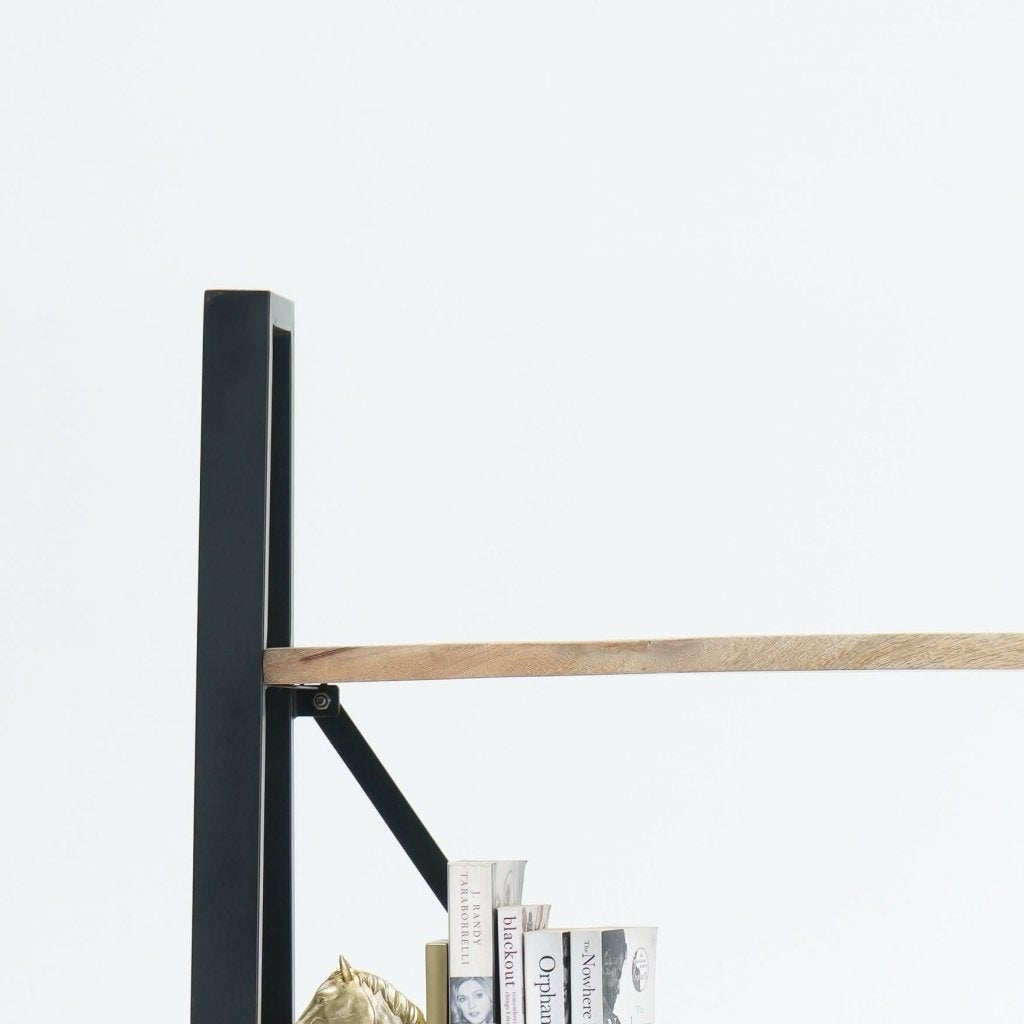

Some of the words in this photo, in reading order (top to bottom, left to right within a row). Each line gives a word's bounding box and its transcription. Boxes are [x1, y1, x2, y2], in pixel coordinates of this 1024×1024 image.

[460, 872, 469, 965] TARABORRELLI
[471, 891, 480, 899] J.
[472, 904, 481, 946] RANDY
[503, 916, 518, 988] blackout
[534, 955, 556, 1024] Orphan
[582, 954, 596, 1019] Nowhere
